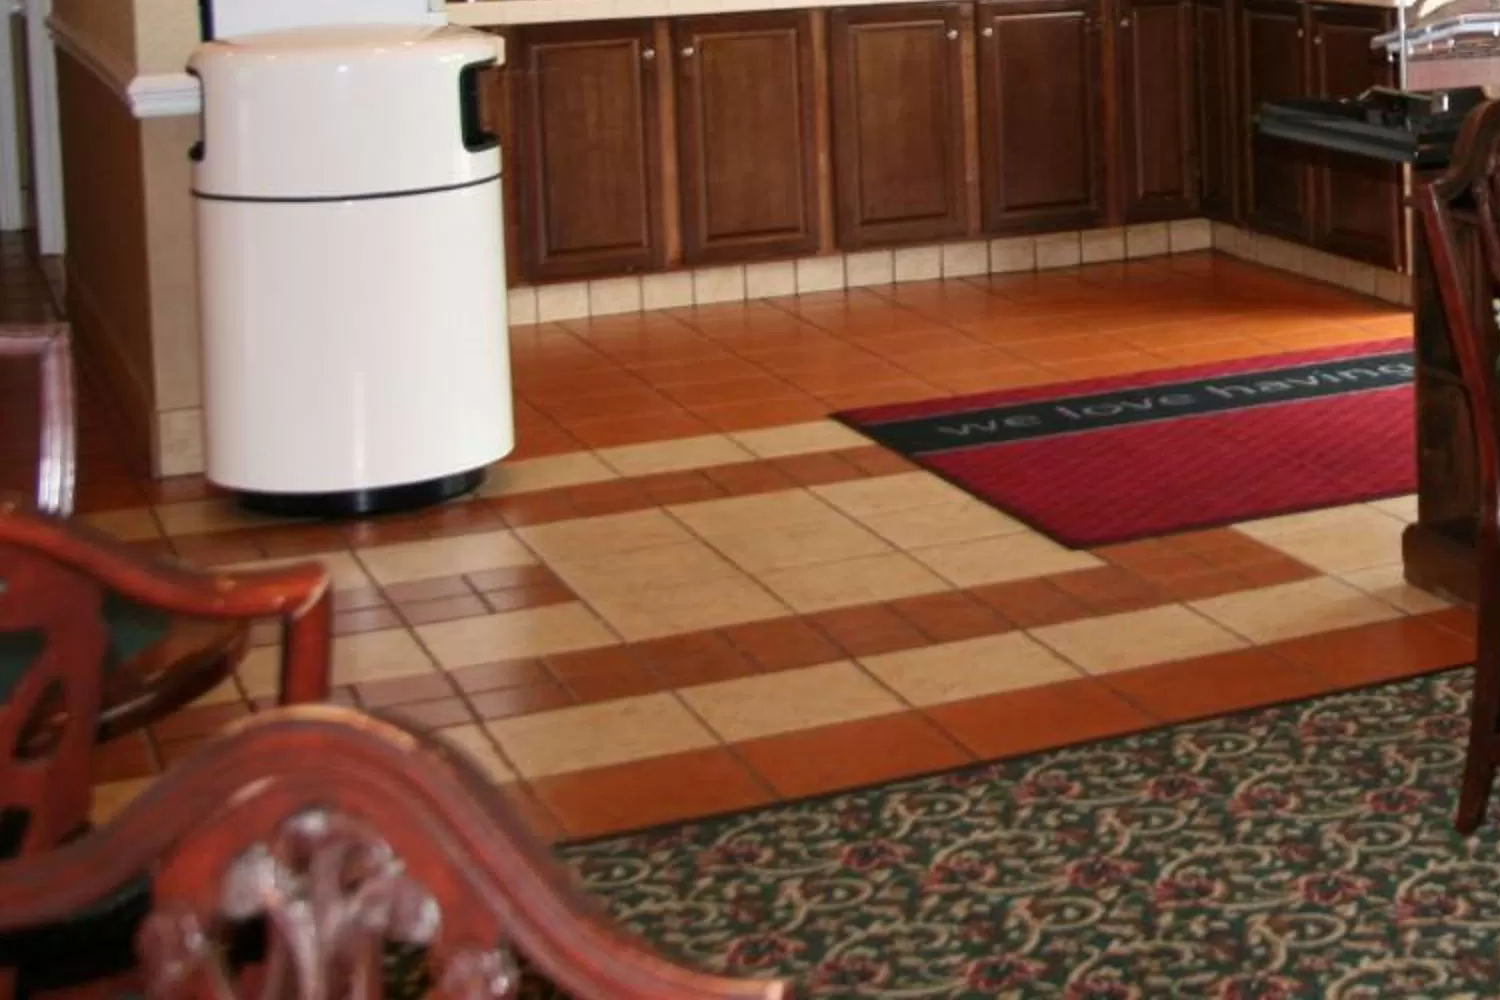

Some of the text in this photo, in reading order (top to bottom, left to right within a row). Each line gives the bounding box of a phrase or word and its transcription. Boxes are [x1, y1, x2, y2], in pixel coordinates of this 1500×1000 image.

[937, 362, 1414, 437] we love having
